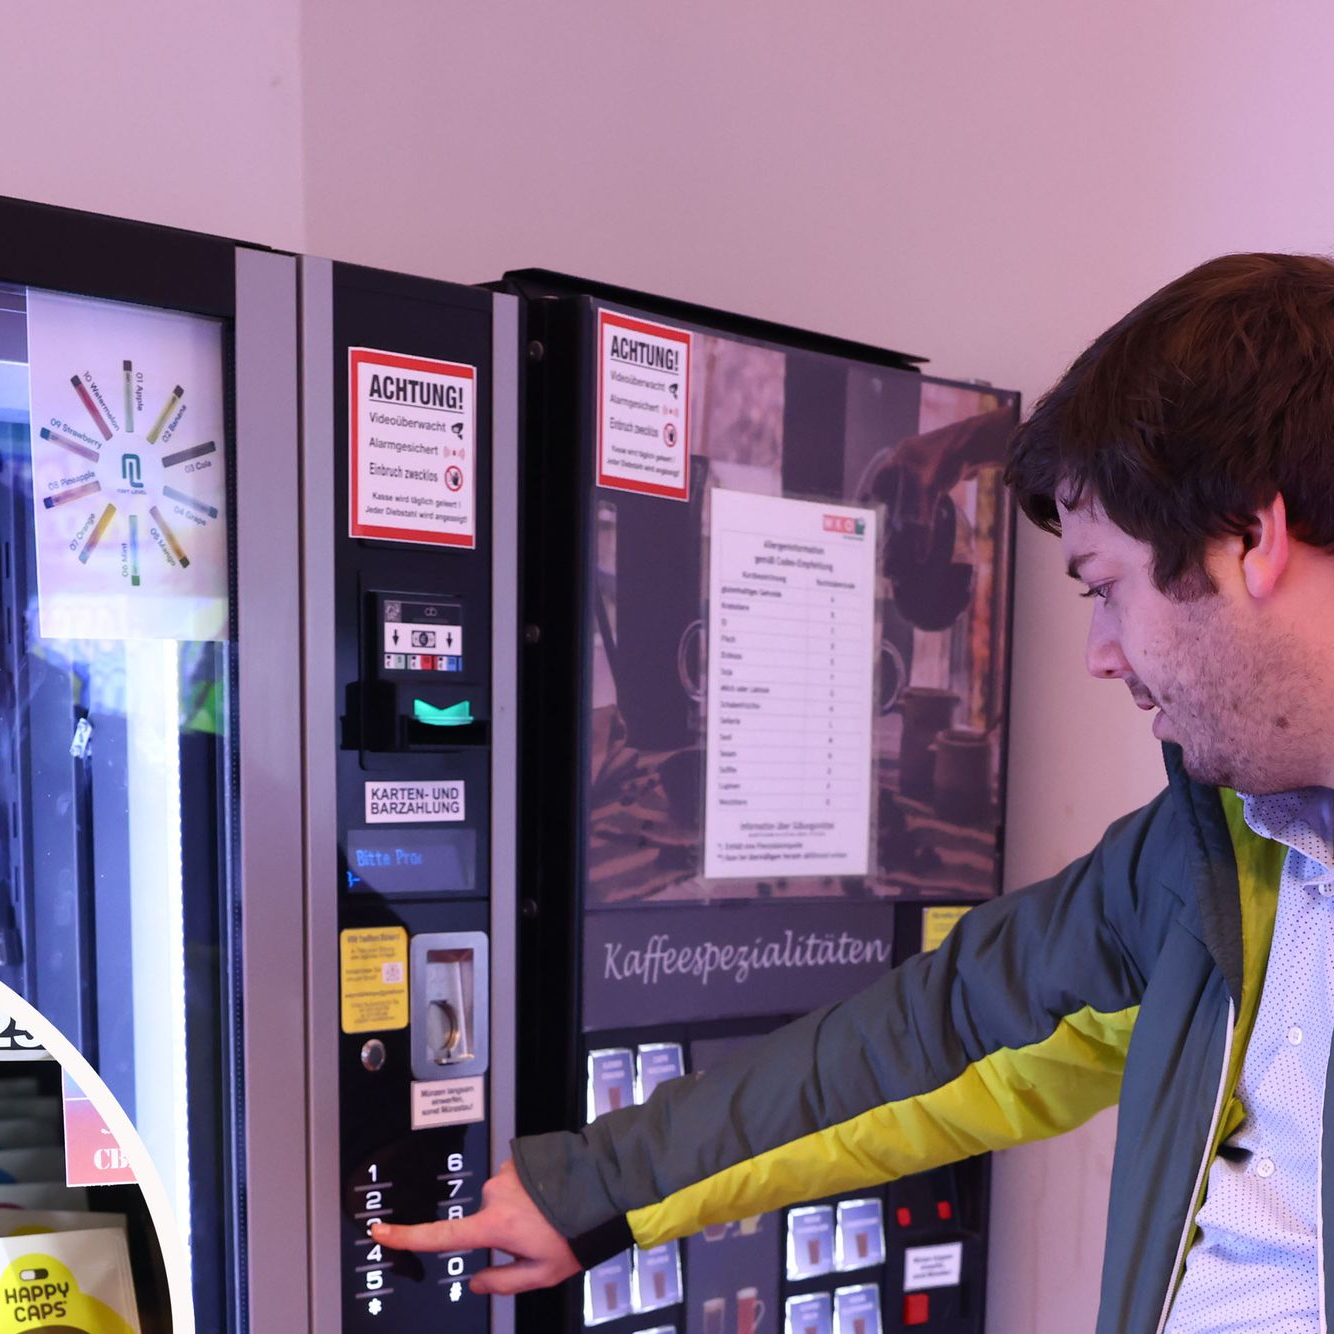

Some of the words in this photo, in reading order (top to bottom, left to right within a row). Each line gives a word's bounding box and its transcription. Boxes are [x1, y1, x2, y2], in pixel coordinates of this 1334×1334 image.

[610, 335, 679, 371] ACHTUNG!
[135, 385, 144, 411] Apple
[369, 374, 464, 410] ACHTUNG!
[90, 382, 121, 432] Watermelon
[168, 405, 187, 432] Banana
[369, 412, 447, 433] Videoüberwacht
[62, 423, 103, 450] Strawberry
[369, 437, 439, 456] Alarmgesichert
[195, 460, 212, 470] Cola
[369, 462, 403, 478] Einbruch
[404, 466, 439, 482] zwecklos
[60, 470, 96, 486] Pineapple
[76, 513, 96, 540] Orange
[185, 511, 207, 526] Grape
[158, 540, 176, 567] Mango
[371, 788, 430, 800] KARTEN-
[432, 787, 460, 800] UND
[370, 801, 460, 815] BARZAHLUNG
[604, 929, 891, 985] Kaffeespezialitäten
[447, 1153, 463, 1171] 6
[368, 1164, 377, 1182] 1
[447, 1180, 463, 1197] 7
[366, 1191, 382, 1209] 2
[367, 1244, 383, 1262] 4
[447, 1257, 464, 1276] 0
[367, 1270, 383, 1290] 5
[4, 1282, 70, 1305] HAPPY
[13, 1300, 67, 1322] CAPS
